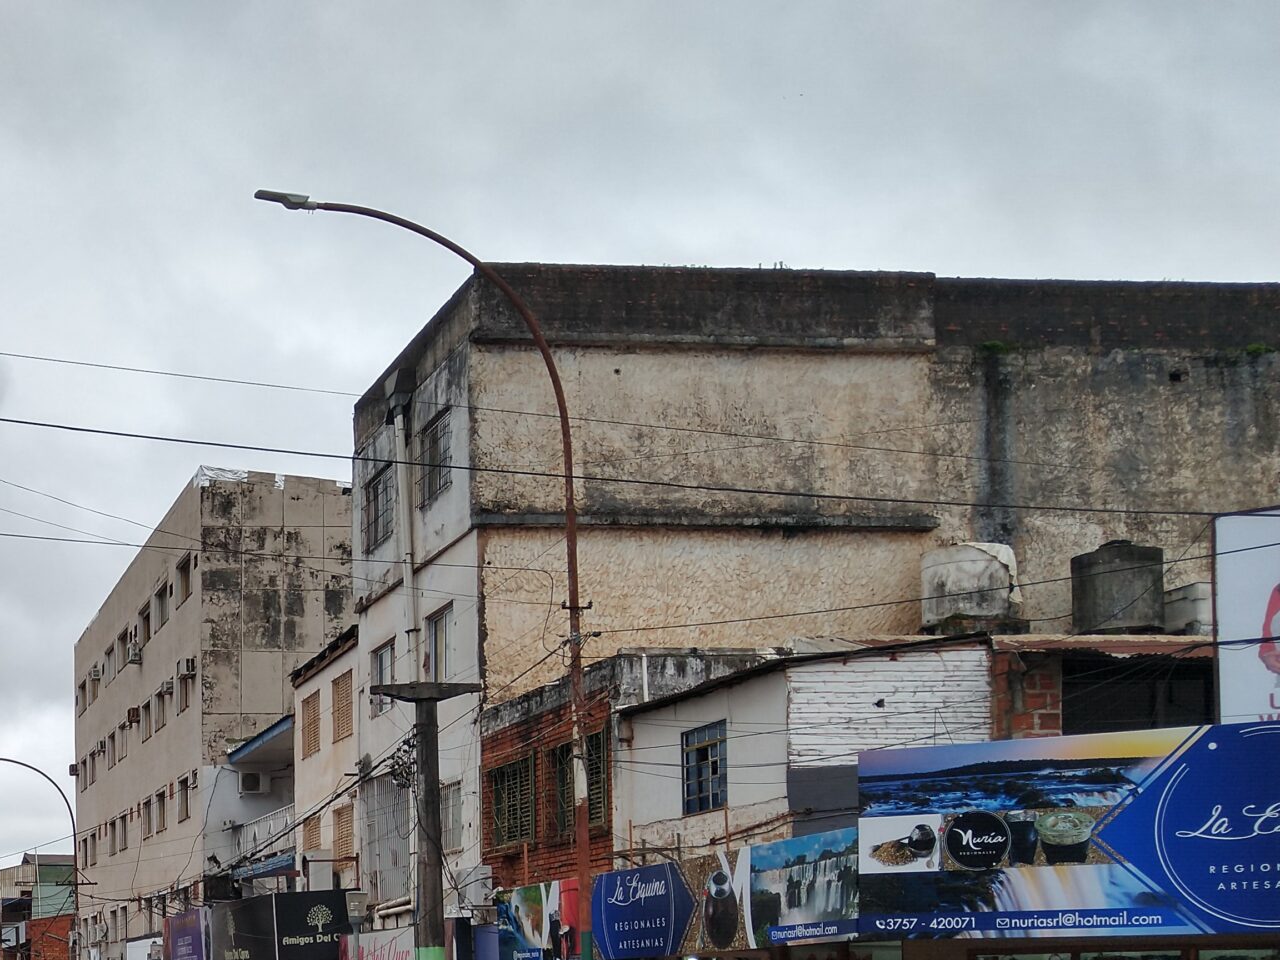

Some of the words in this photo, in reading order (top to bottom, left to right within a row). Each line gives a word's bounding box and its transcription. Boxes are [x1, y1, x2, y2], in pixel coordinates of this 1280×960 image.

[1175, 805, 1233, 840] La
[952, 828, 1007, 850] Nuría
[607, 876, 624, 905] La
[626, 873, 667, 906] Esquina
[614, 917, 666, 931] REGIONALES
[885, 918, 918, 930] 3757
[929, 917, 976, 930] 420071
[1011, 910, 1162, 928] nuriasrl@hotmail.com
[282, 936, 314, 946] Amigos
[316, 934, 331, 943] Del
[777, 923, 838, 942] nuriasrl@hotmail.com
[618, 937, 664, 949] ARTESANIAS
